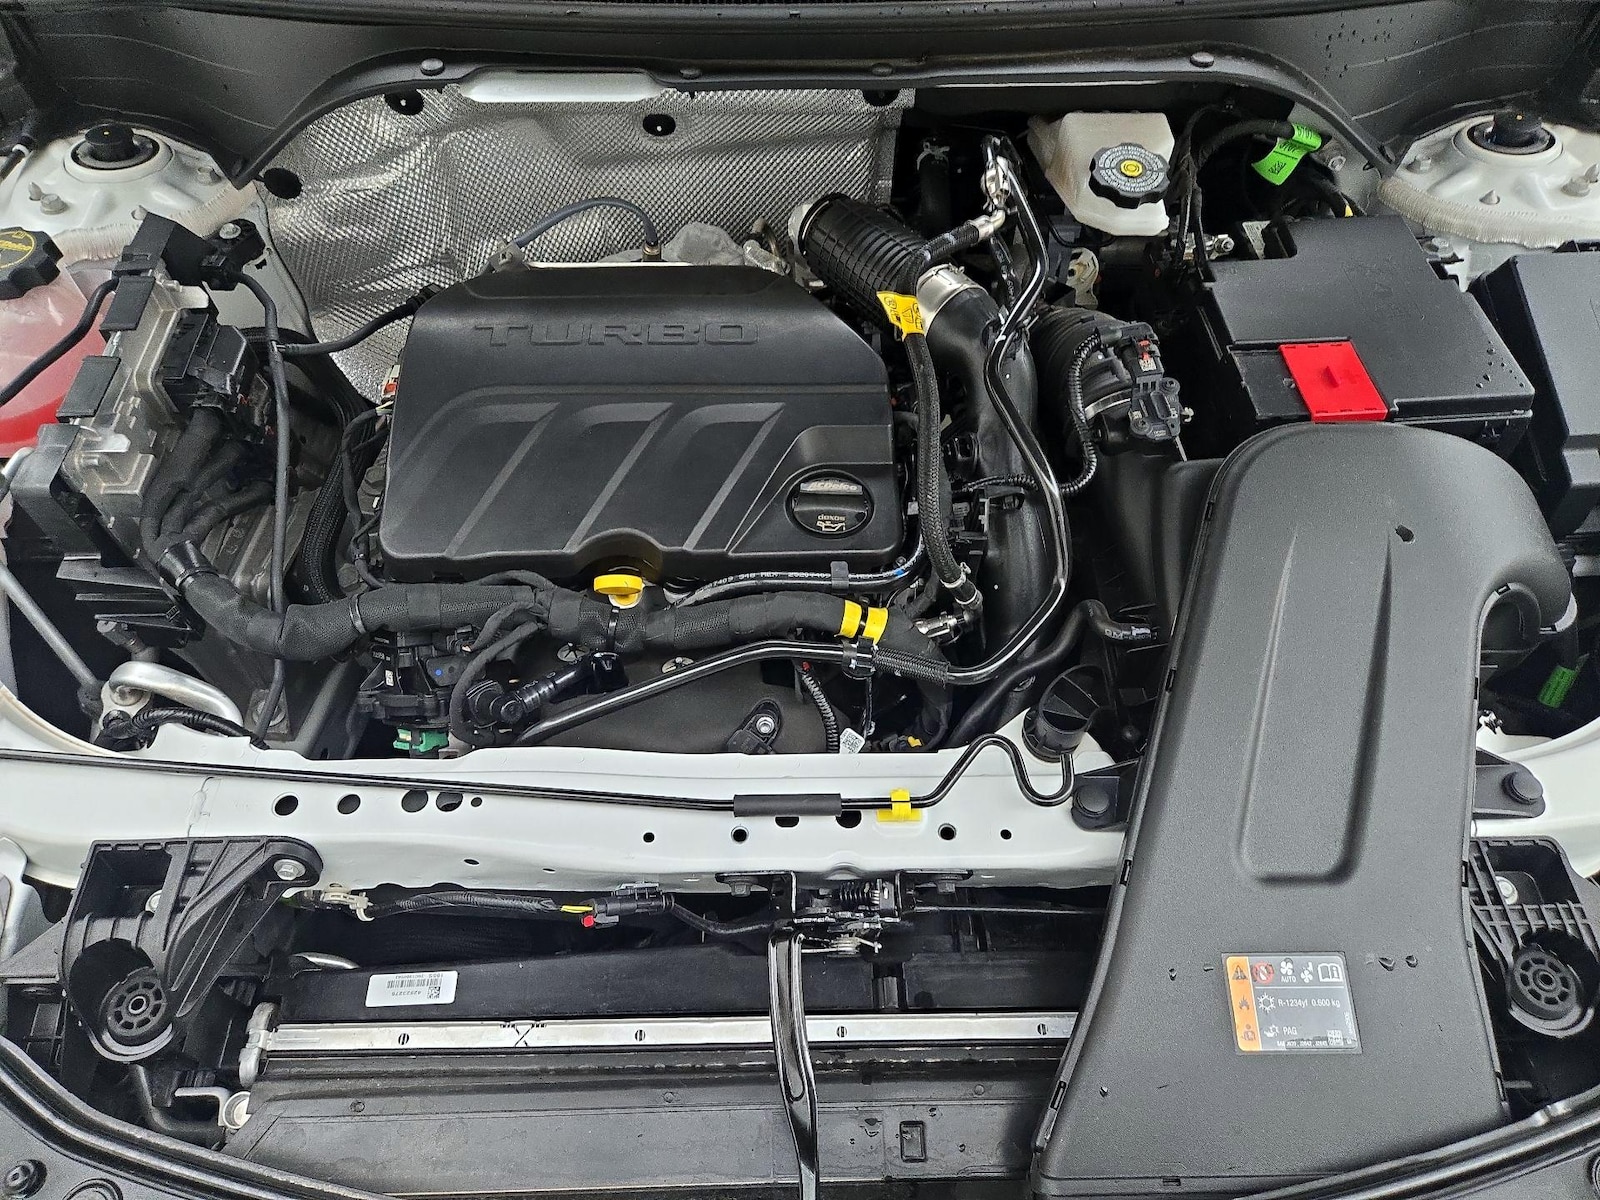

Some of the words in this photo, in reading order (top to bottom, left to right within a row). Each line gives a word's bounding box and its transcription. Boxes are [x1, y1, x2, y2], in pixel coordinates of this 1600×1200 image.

[474, 324, 759, 346] TURBO
[1331, 999, 1341, 1008] kg
[1282, 1026, 1298, 1036] PAG
